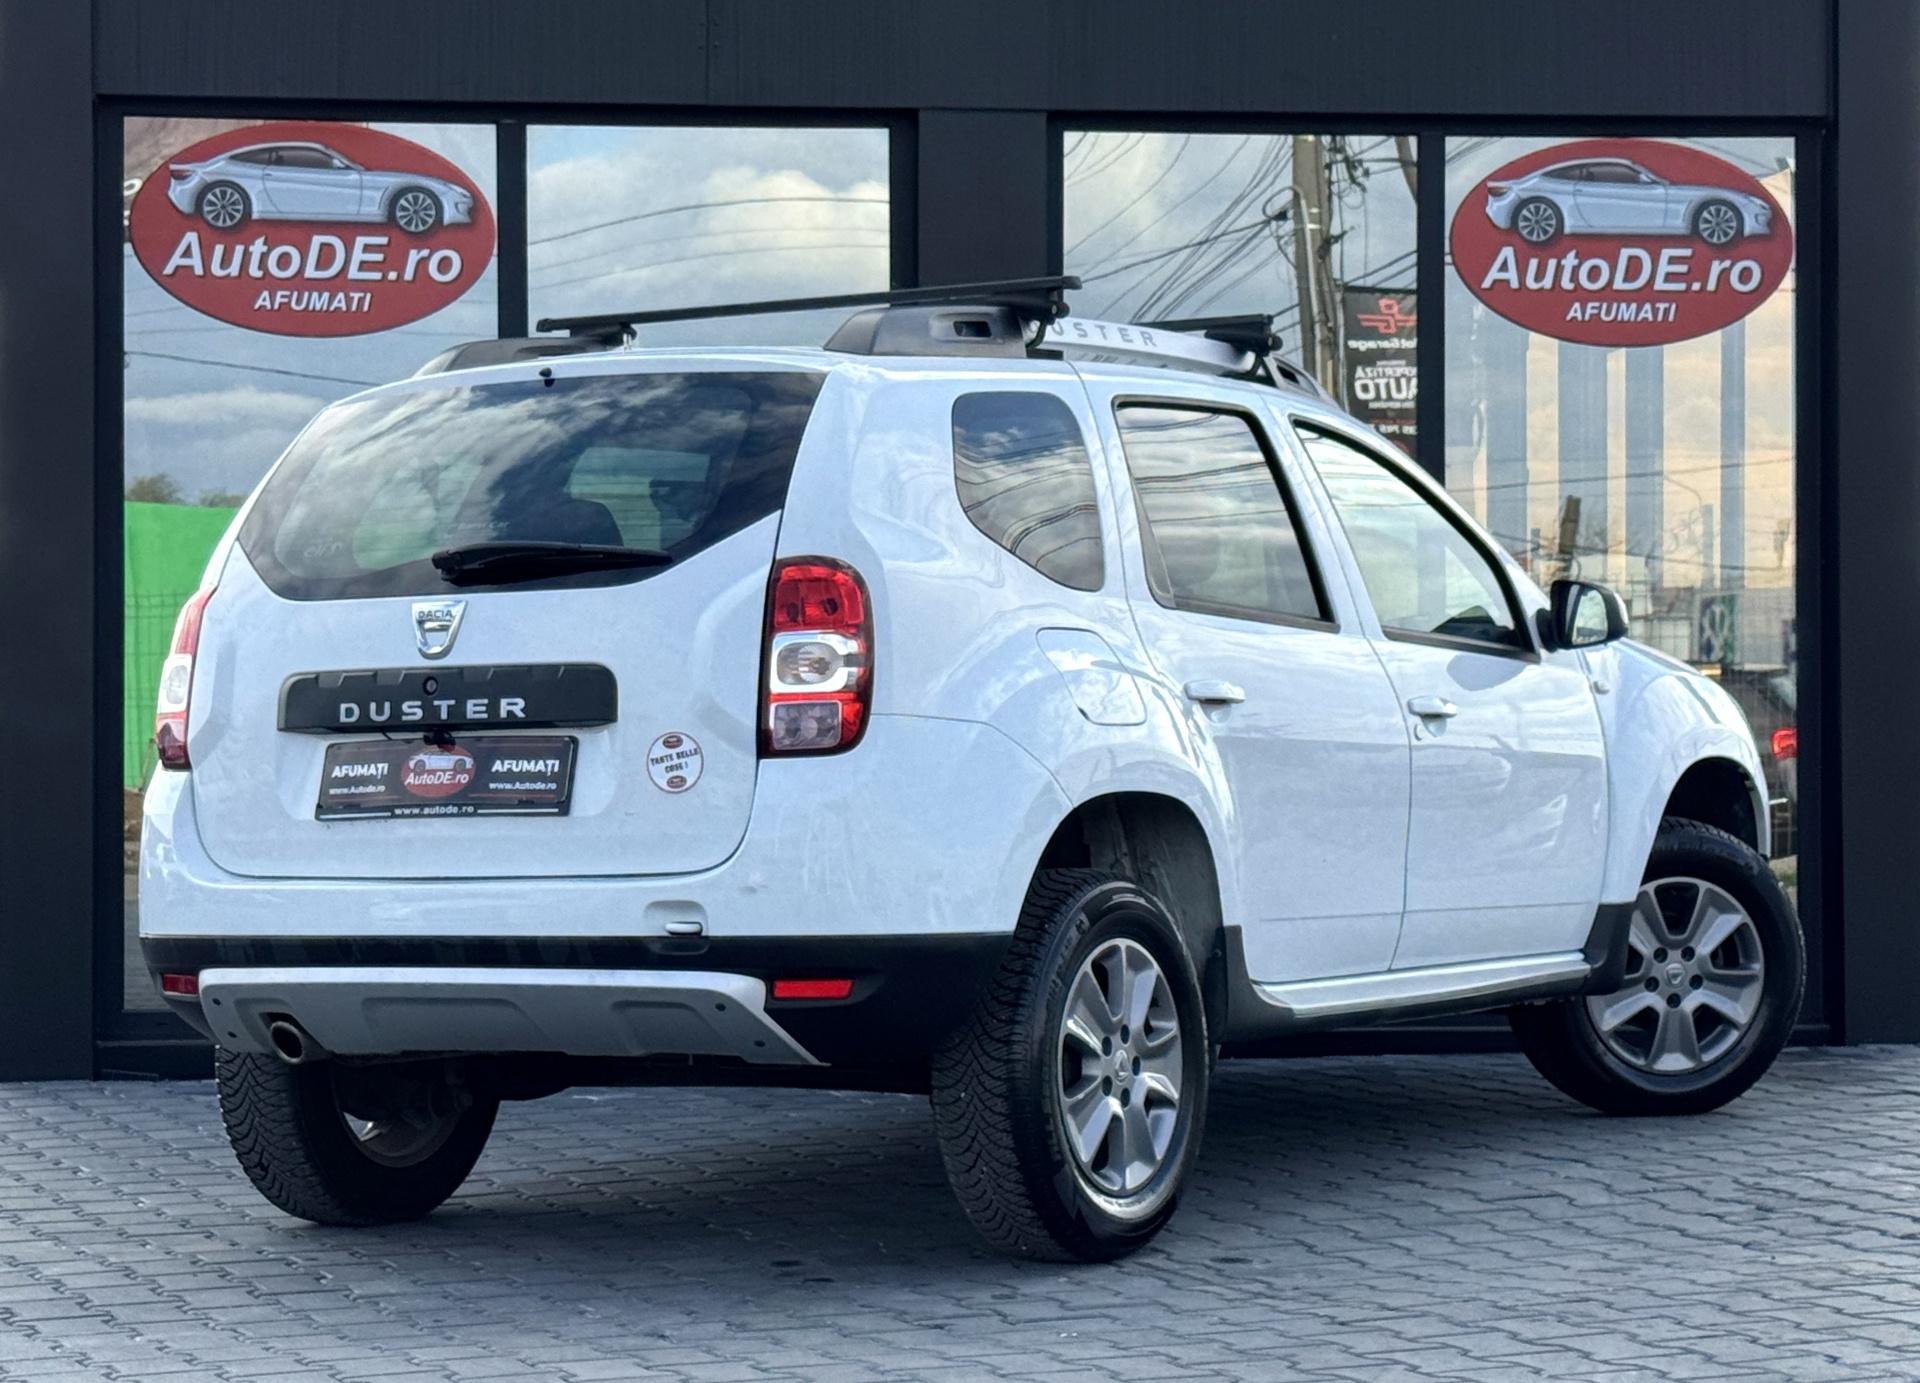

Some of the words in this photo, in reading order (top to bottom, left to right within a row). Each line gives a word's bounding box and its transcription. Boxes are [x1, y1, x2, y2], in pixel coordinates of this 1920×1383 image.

[163, 231, 463, 284] AutoDE.ro
[1481, 246, 1763, 294] AutoDE.ro
[254, 289, 372, 313] AFUMATI
[1565, 301, 1677, 323] AFUMATI
[417, 609, 454, 620] DACIA
[338, 697, 528, 724] DUSTER
[403, 769, 470, 787] AutoDE.ro
[393, 804, 475, 817] www.autode.ro
